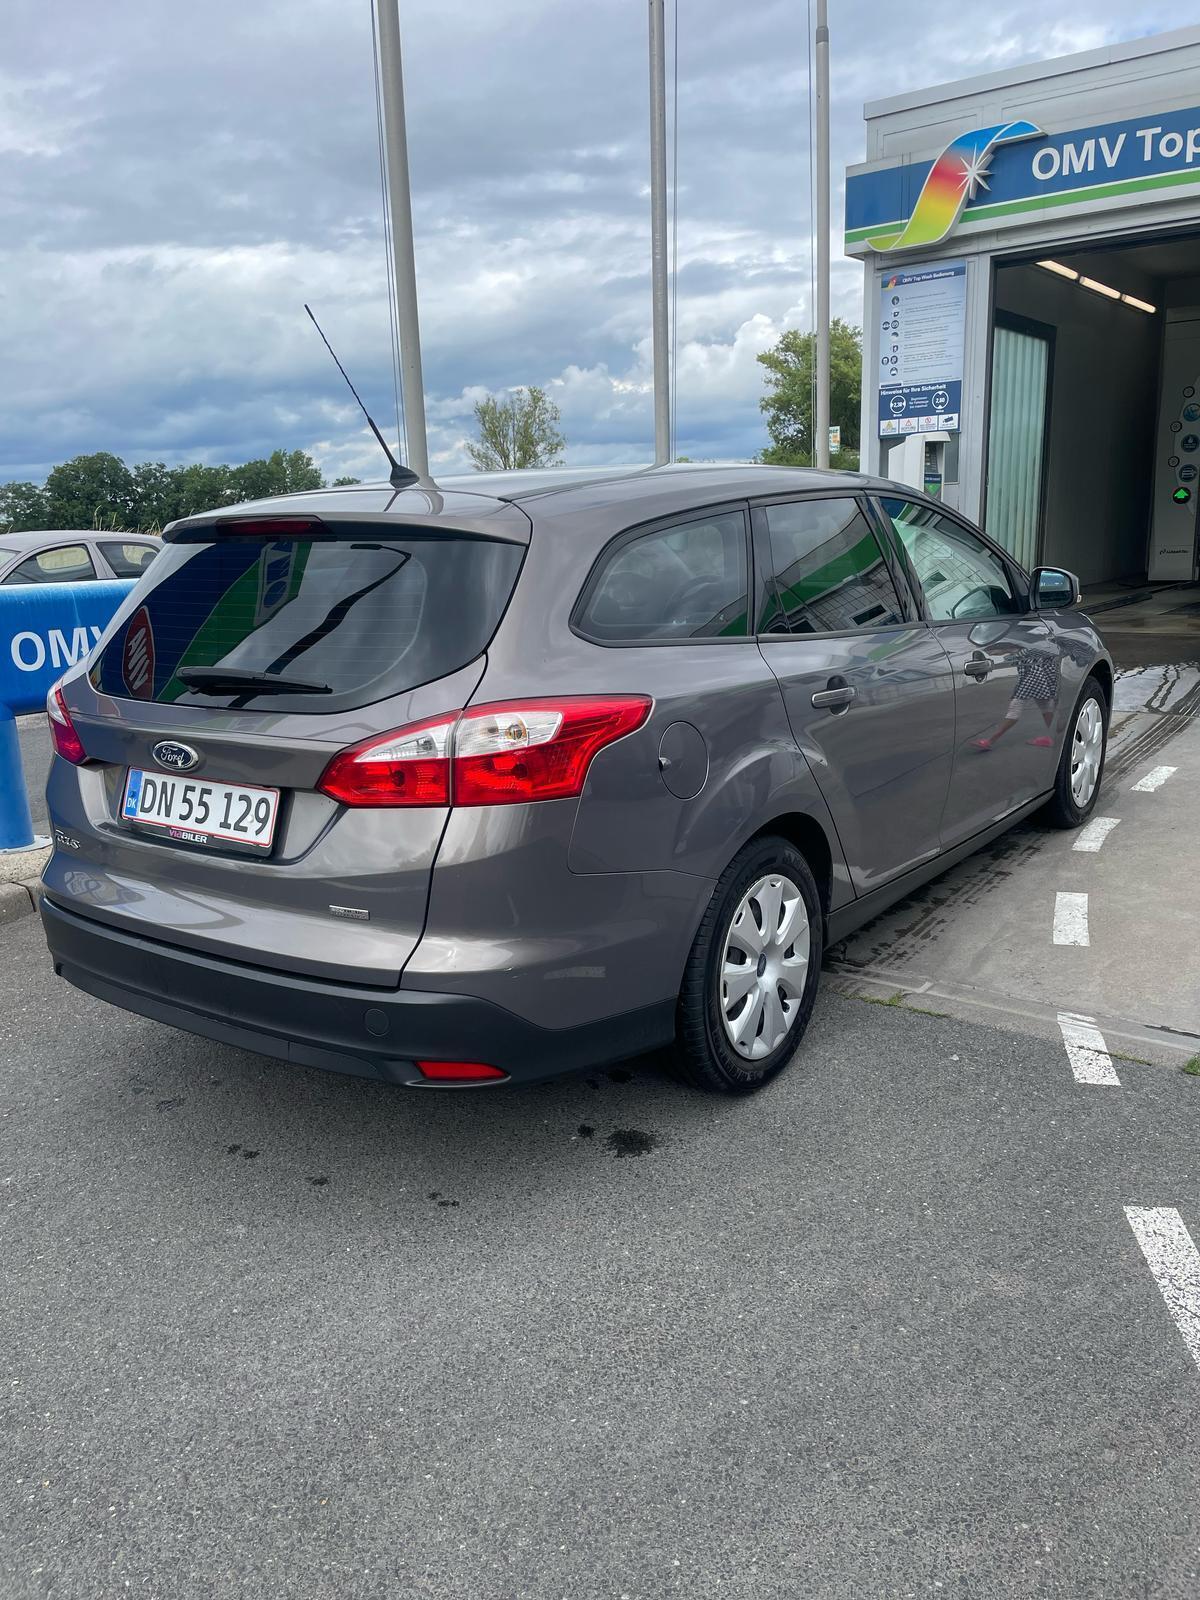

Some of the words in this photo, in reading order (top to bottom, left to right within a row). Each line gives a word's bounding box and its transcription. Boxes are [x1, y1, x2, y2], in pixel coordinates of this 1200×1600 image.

[1031, 132, 1127, 181] OMV
[1135, 126, 1200, 163] Top
[160, 745, 184, 762] Ford
[127, 797, 137, 809] DK
[139, 778, 176, 818] DN
[178, 784, 213, 825] 55
[219, 792, 271, 836] 129
